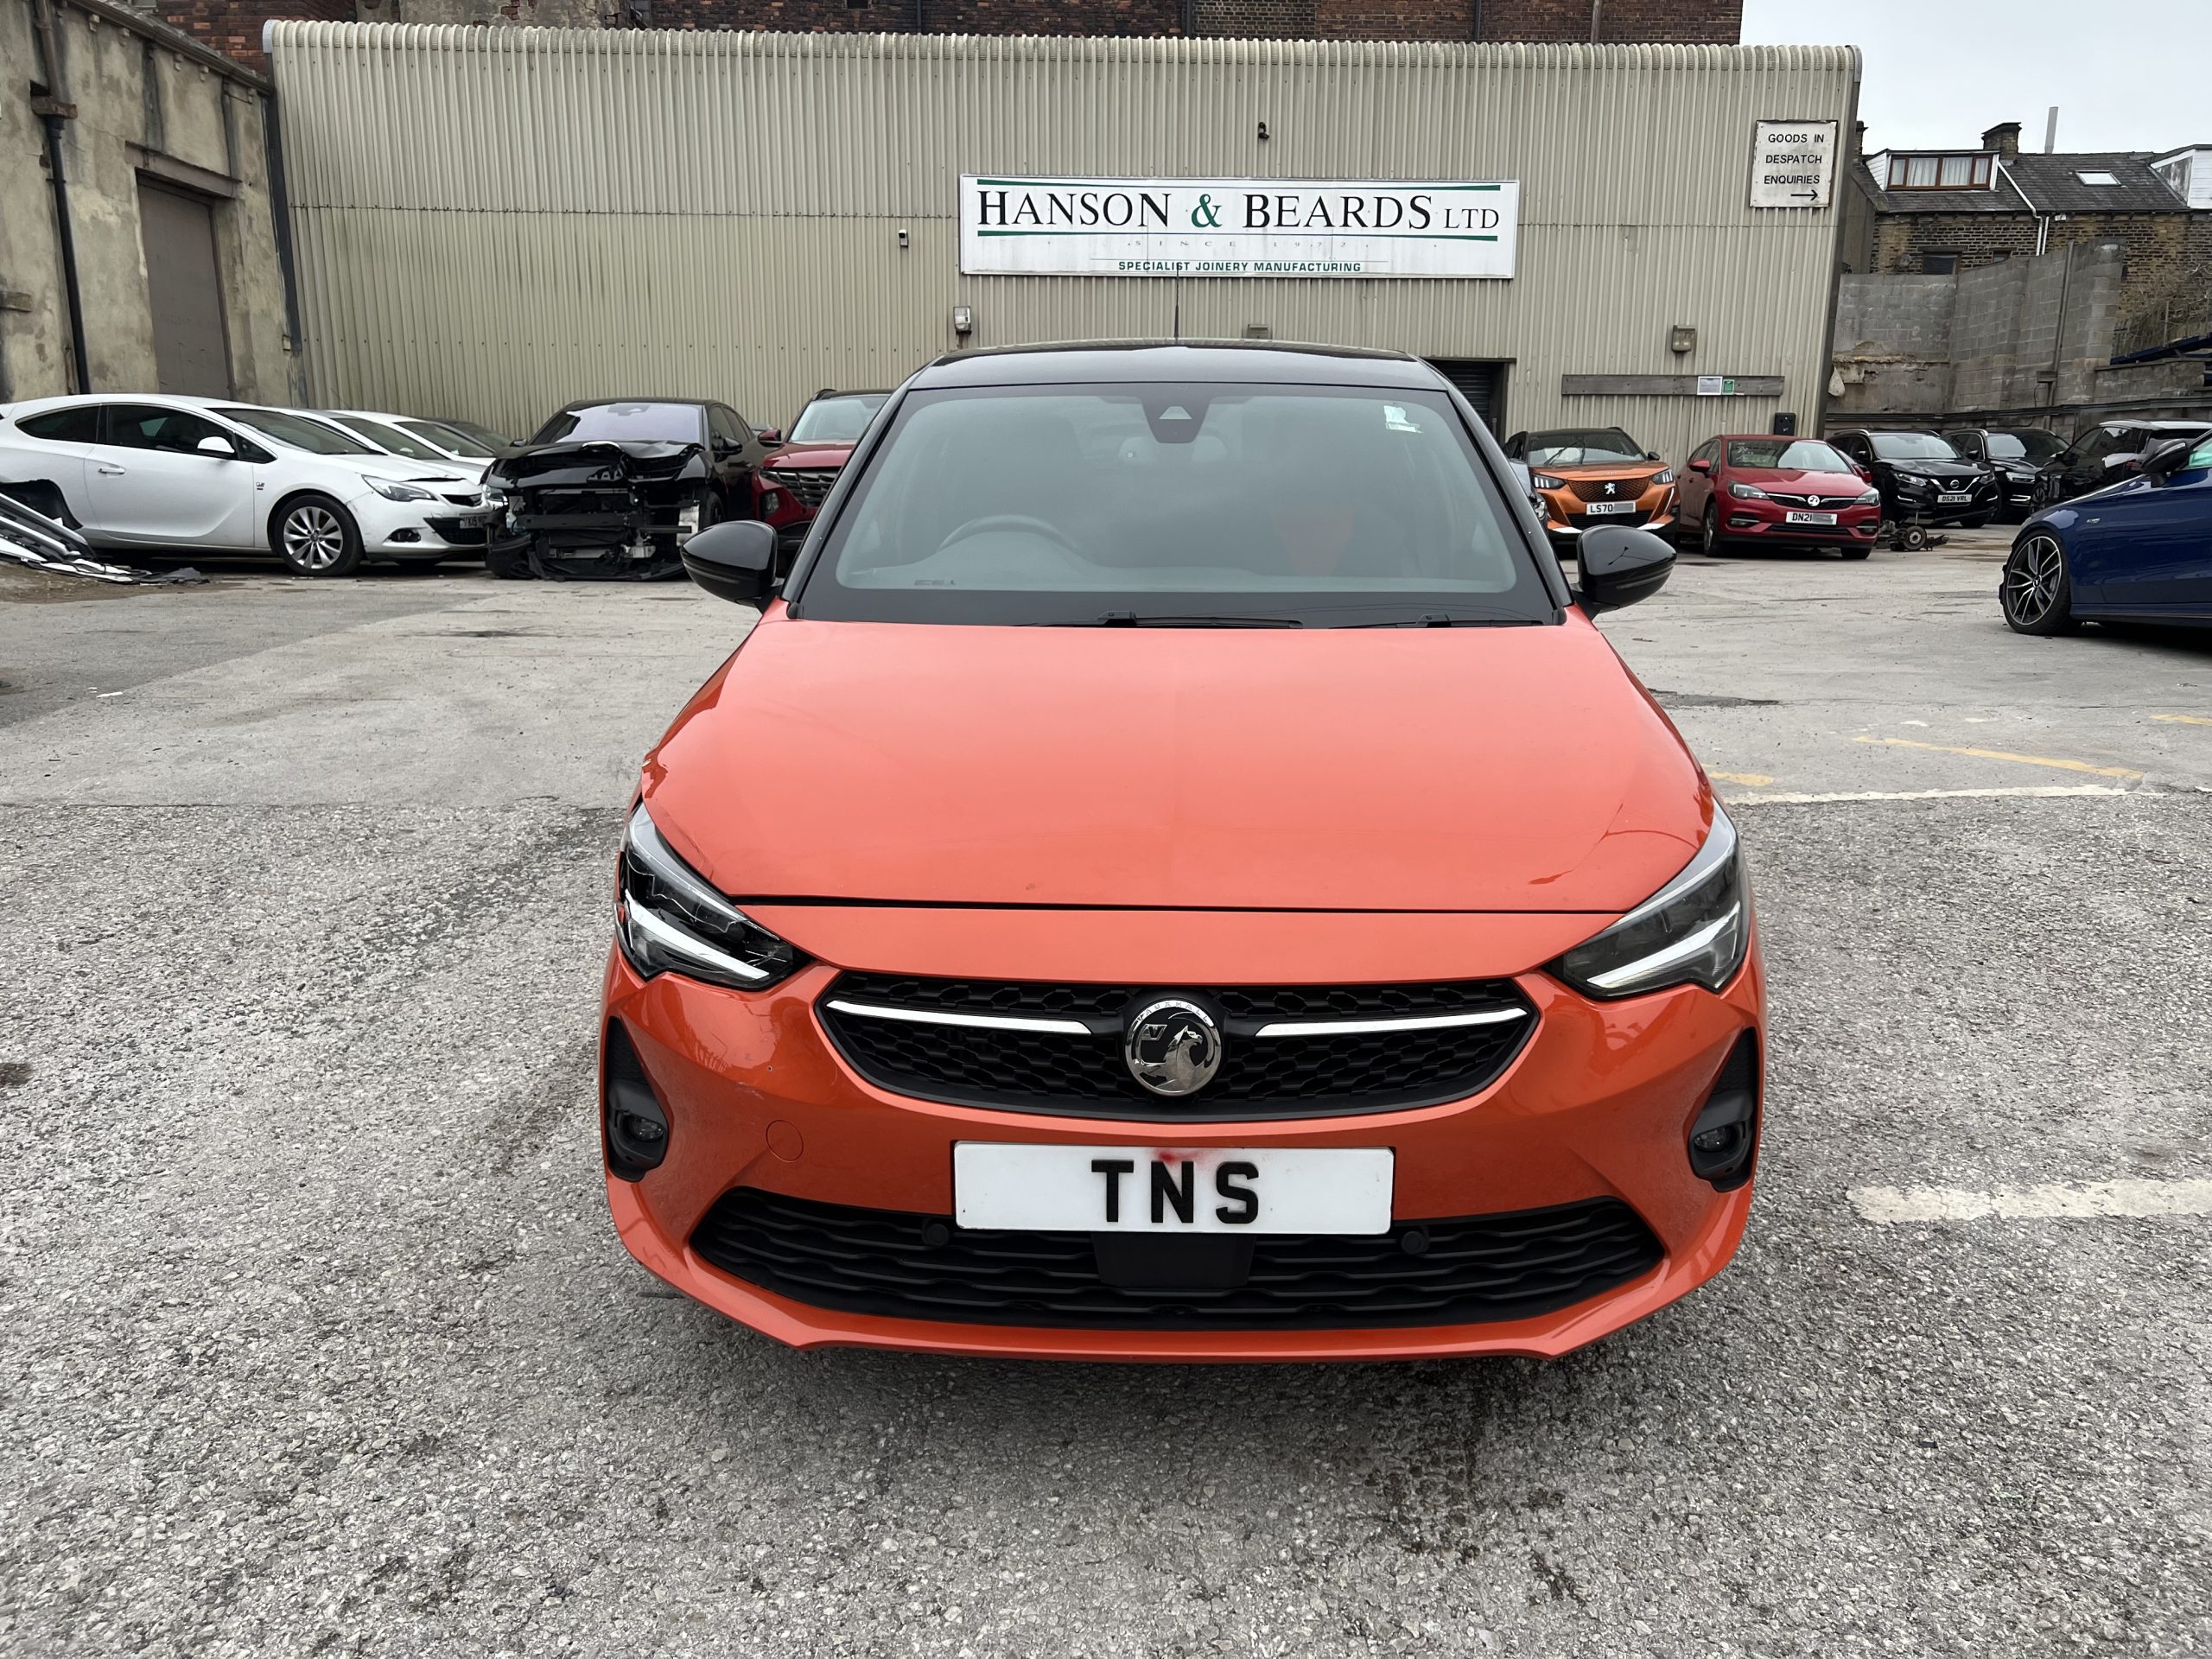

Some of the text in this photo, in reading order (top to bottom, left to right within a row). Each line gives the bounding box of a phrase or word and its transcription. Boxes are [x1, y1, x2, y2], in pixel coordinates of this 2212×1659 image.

[1768, 134, 1825, 143] GOODS IN
[1765, 155, 1822, 164] DESPATCH
[1764, 175, 1821, 184] ENQUIRIES
[977, 190, 1499, 230] HANSON & BEARDS LTD
[1118, 262, 1362, 272] SPECIALIST JOINERY MANUFACTURING
[1590, 504, 1613, 513] LS70
[1791, 512, 1813, 522] DN21
[1090, 1159, 1260, 1224] TNS
